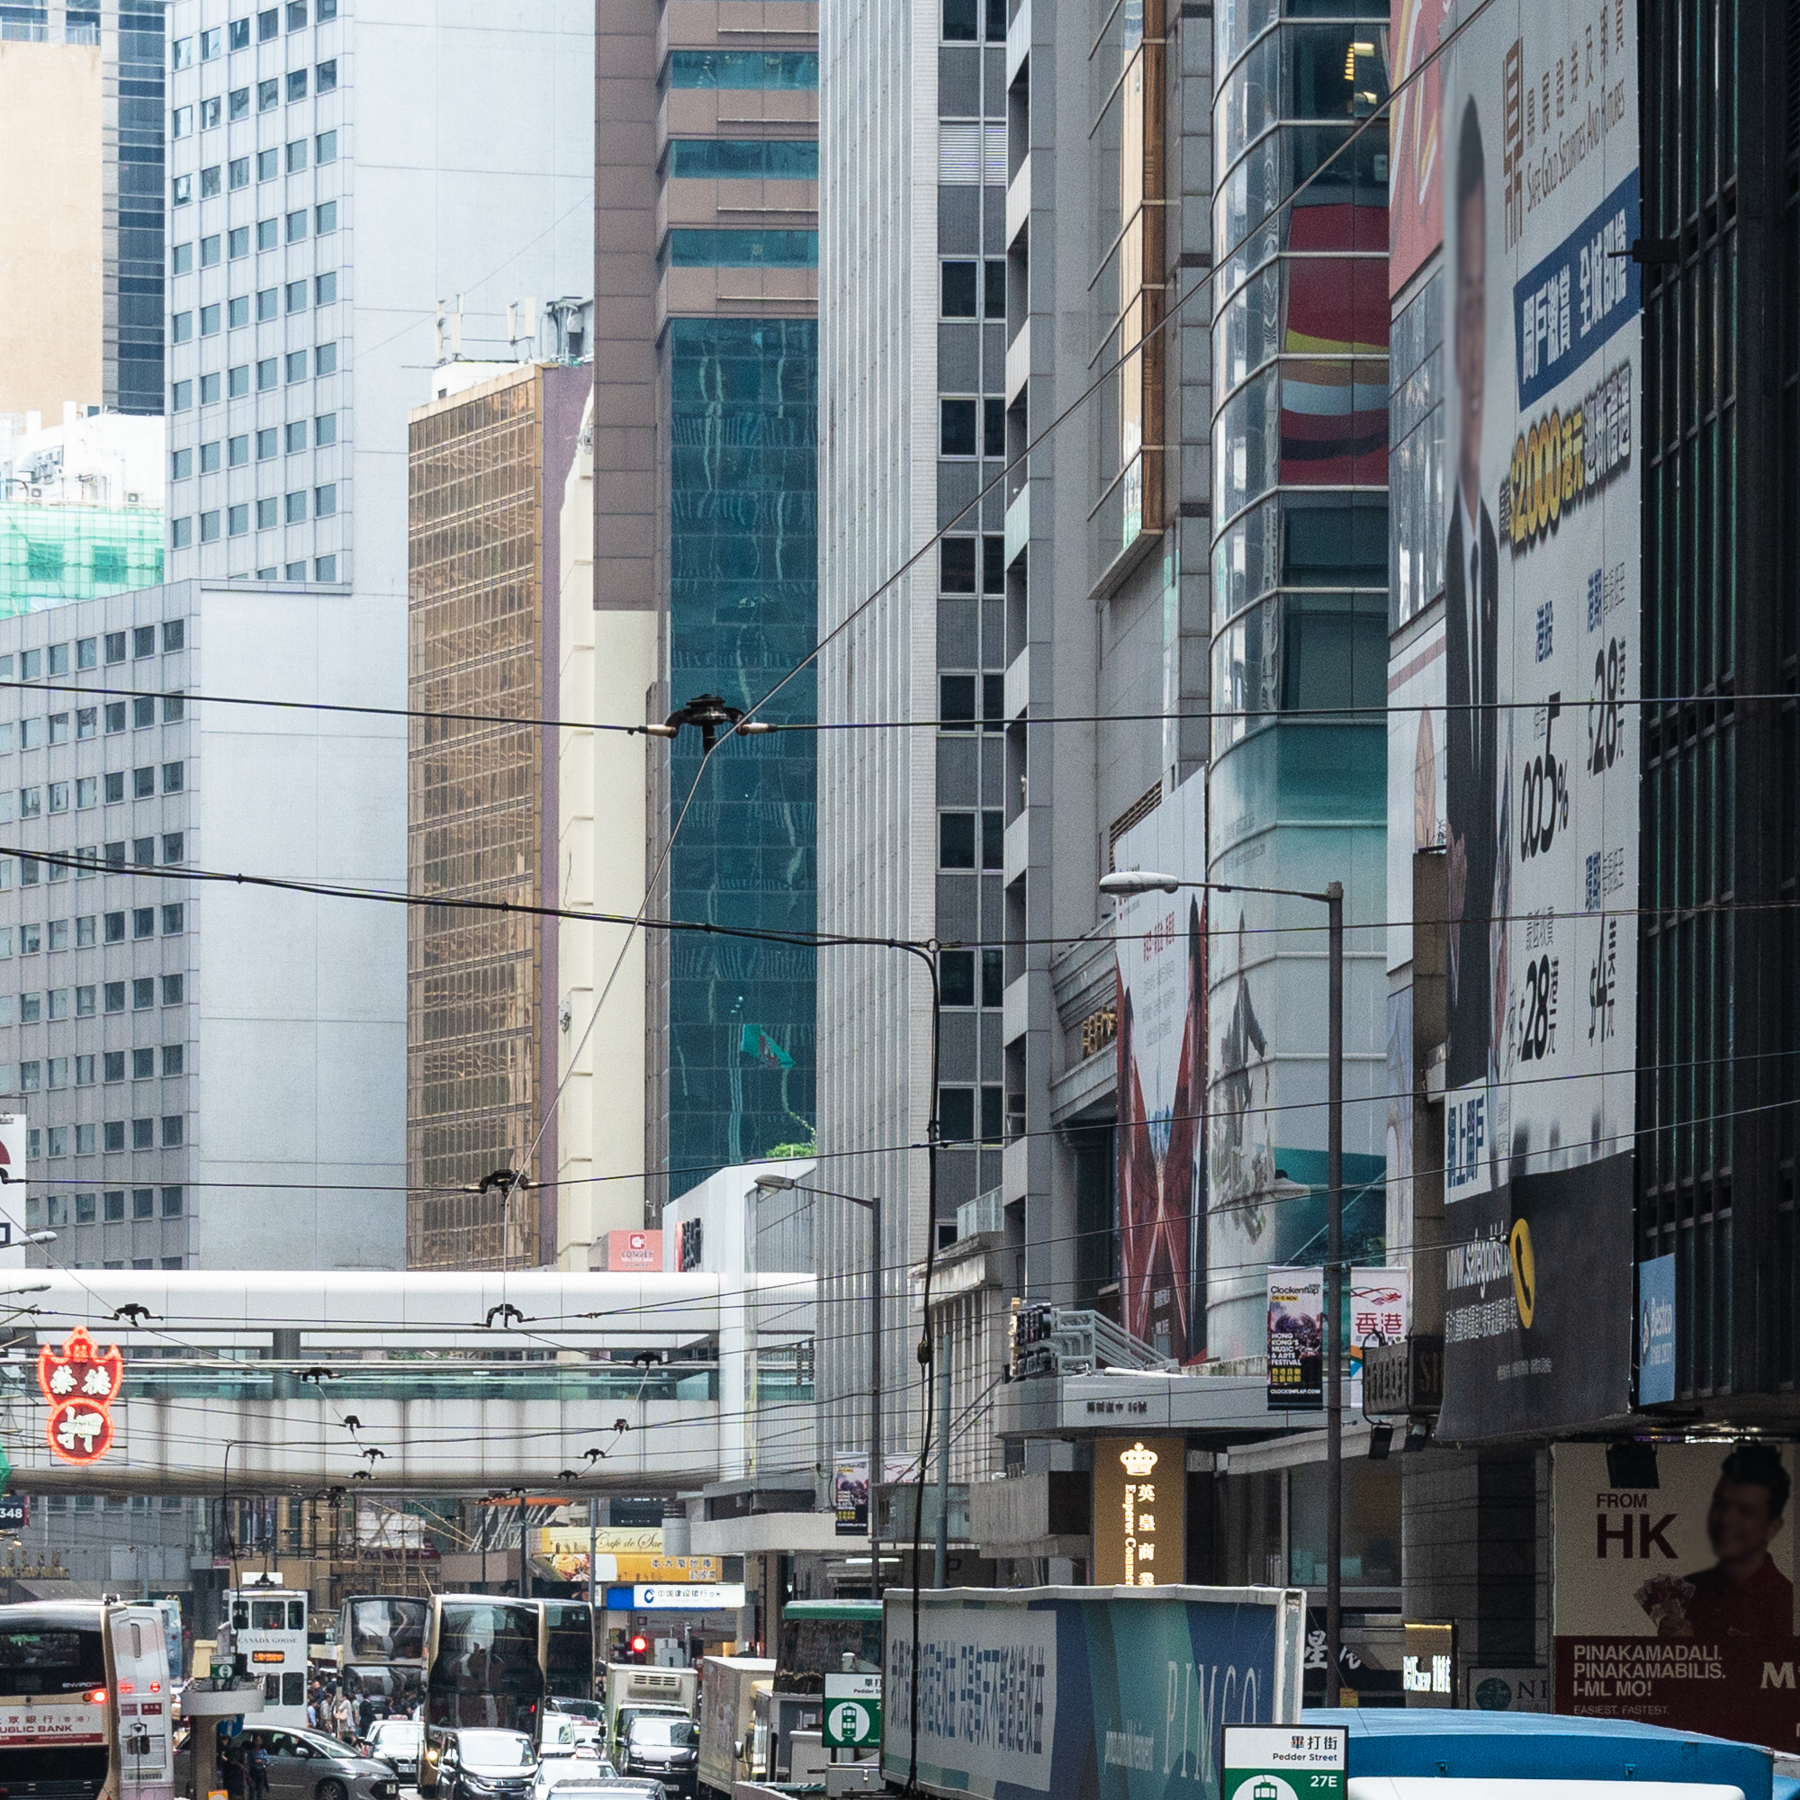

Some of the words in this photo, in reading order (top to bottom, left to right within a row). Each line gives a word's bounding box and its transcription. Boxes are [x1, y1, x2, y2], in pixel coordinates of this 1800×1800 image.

[1526, 164, 1542, 215] SAFE
[1541, 152, 1559, 202] GOLD
[1558, 126, 1587, 184] SECURITIES
[1585, 104, 1601, 153] AND
[1599, 78, 1626, 131] FUTURES
[1270, 1285, 1320, 1297] Clockenflap
[1355, 1312, 1403, 1335] 香港
[1597, 1494, 1648, 1509] FROM
[1122, 1484, 1137, 1536] Emperor
[1596, 1513, 1679, 1560] HK
[1574, 1644, 1723, 1662] PINAKAMADALI.
[1574, 1663, 1727, 1680] PINAKAMABILIS.
[1573, 1680, 1612, 1697] I-ML
[1615, 1680, 1653, 1697] MO!
[1574, 1705, 1619, 1715] EASIEST.
[37, 1724, 73, 1733] BANK
[1290, 1735, 1338, 1751] 畢打街
[1272, 1752, 1307, 1761] Pedder
[1309, 1753, 1338, 1761] Street
[1310, 1775, 1338, 1788] 27E
